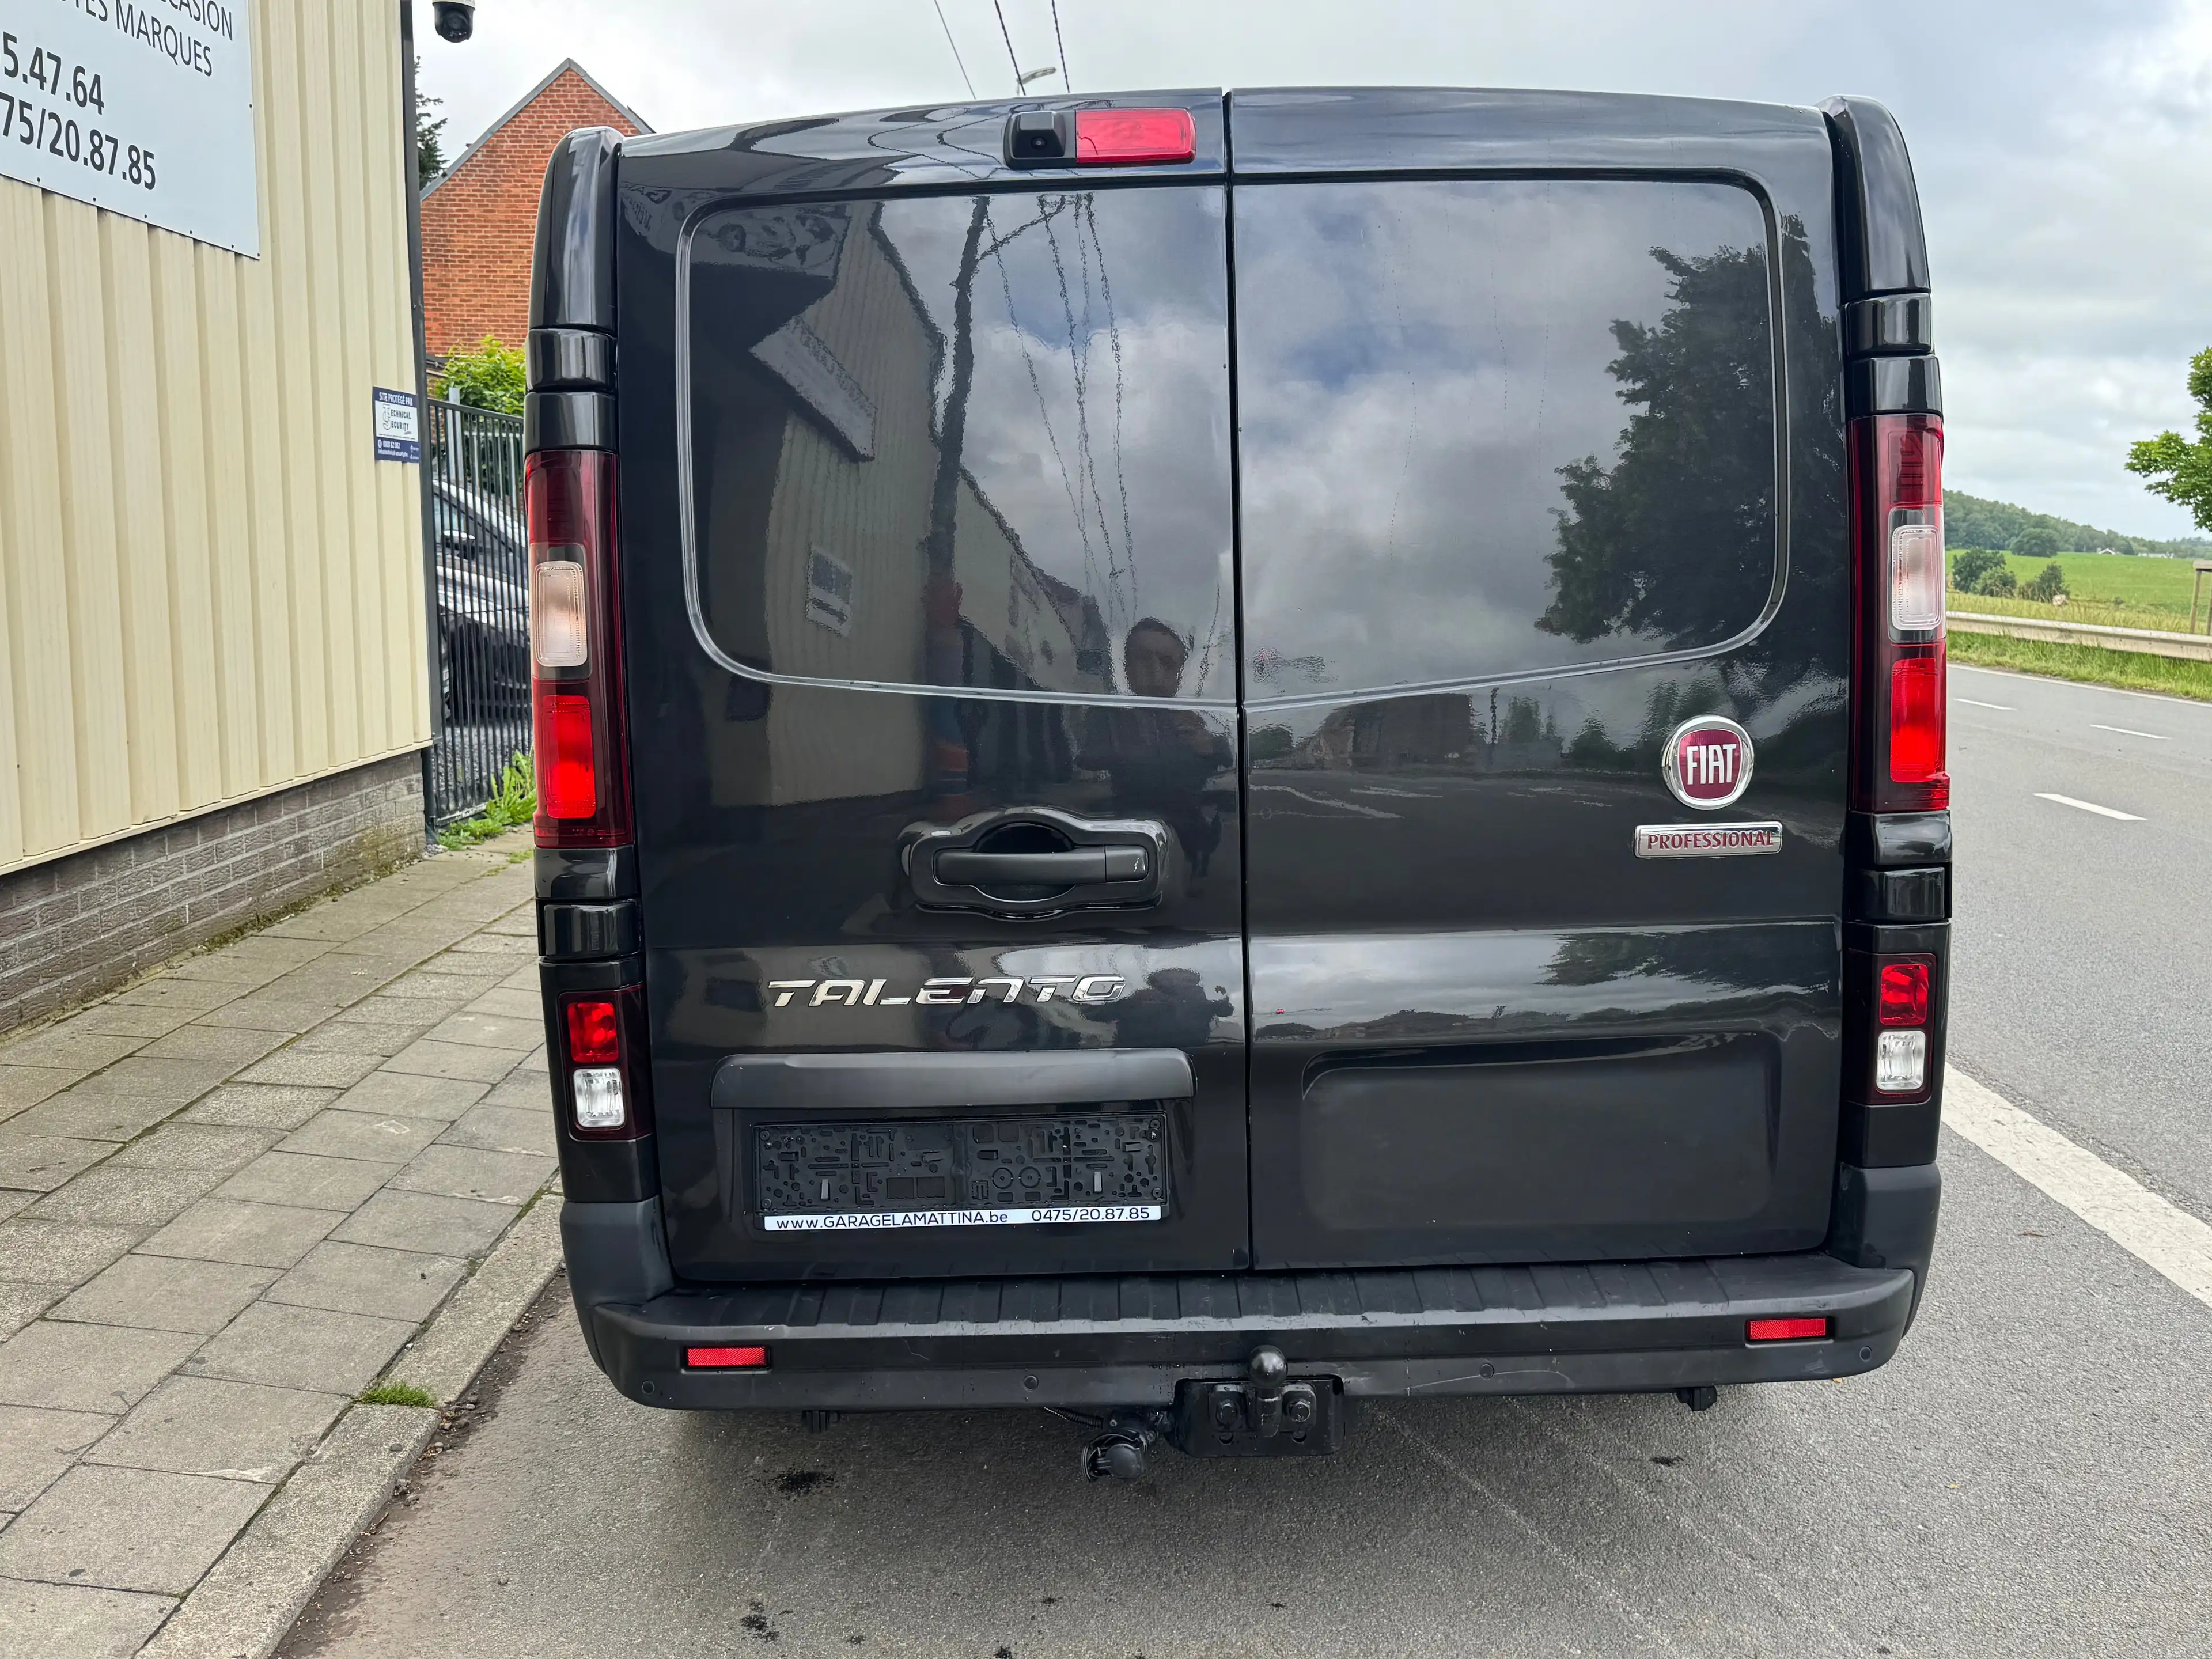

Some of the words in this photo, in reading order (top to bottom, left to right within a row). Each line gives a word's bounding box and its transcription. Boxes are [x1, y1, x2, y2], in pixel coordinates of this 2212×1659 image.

[116, 0, 212, 77] MARQUES
[161, 0, 232, 41] ASION
[3, 31, 104, 115] 5.47.64
[0, 92, 156, 190] 75/20.87.85
[379, 392, 388, 402] SITE
[1687, 744, 1736, 785] FIAT
[1647, 831, 1774, 850] PROFESSIONAL
[768, 974, 1127, 1007] TALENTO
[776, 1211, 1008, 1229] www.GARAGELAMATTINA.be
[1032, 1207, 1150, 1222] 0475/20.87.85
